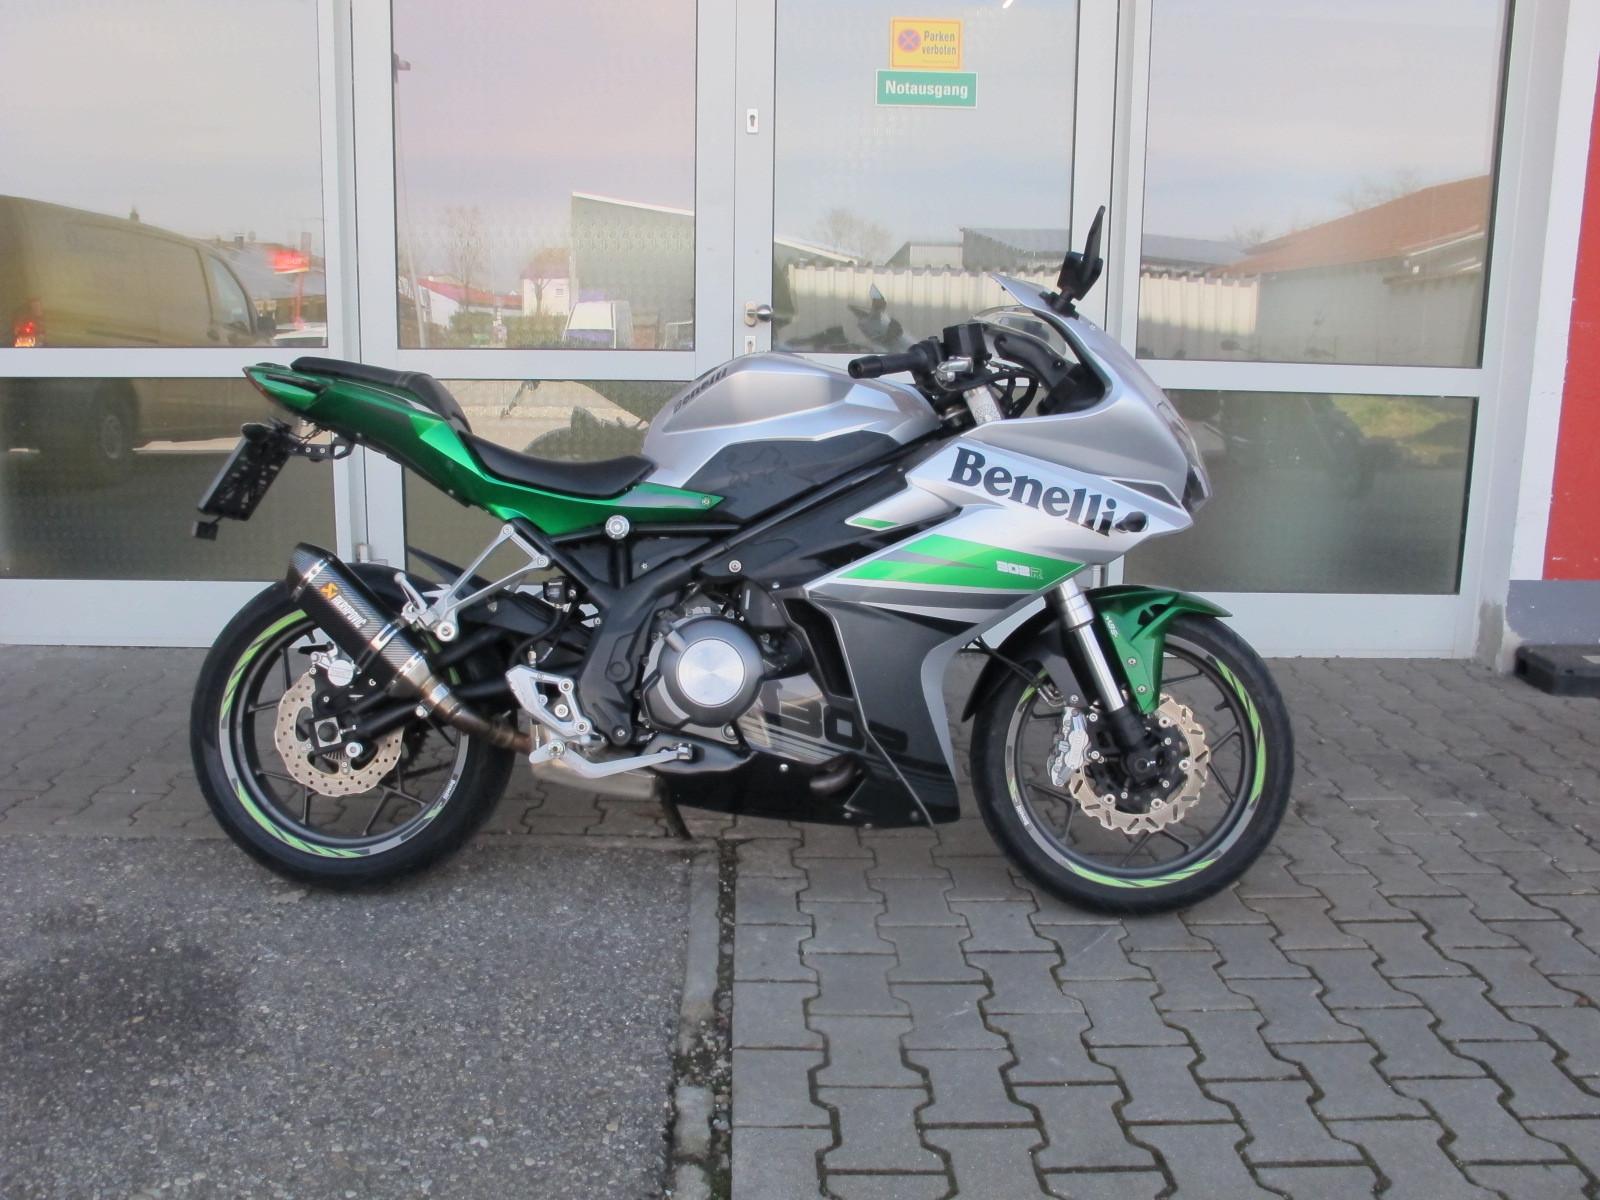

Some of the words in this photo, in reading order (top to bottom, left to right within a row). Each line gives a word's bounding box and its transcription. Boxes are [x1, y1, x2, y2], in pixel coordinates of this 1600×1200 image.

[923, 30, 955, 42] Parken
[921, 44, 957, 56] verboten
[885, 79, 968, 99] Notausgang
[948, 446, 1117, 537] Benelli
